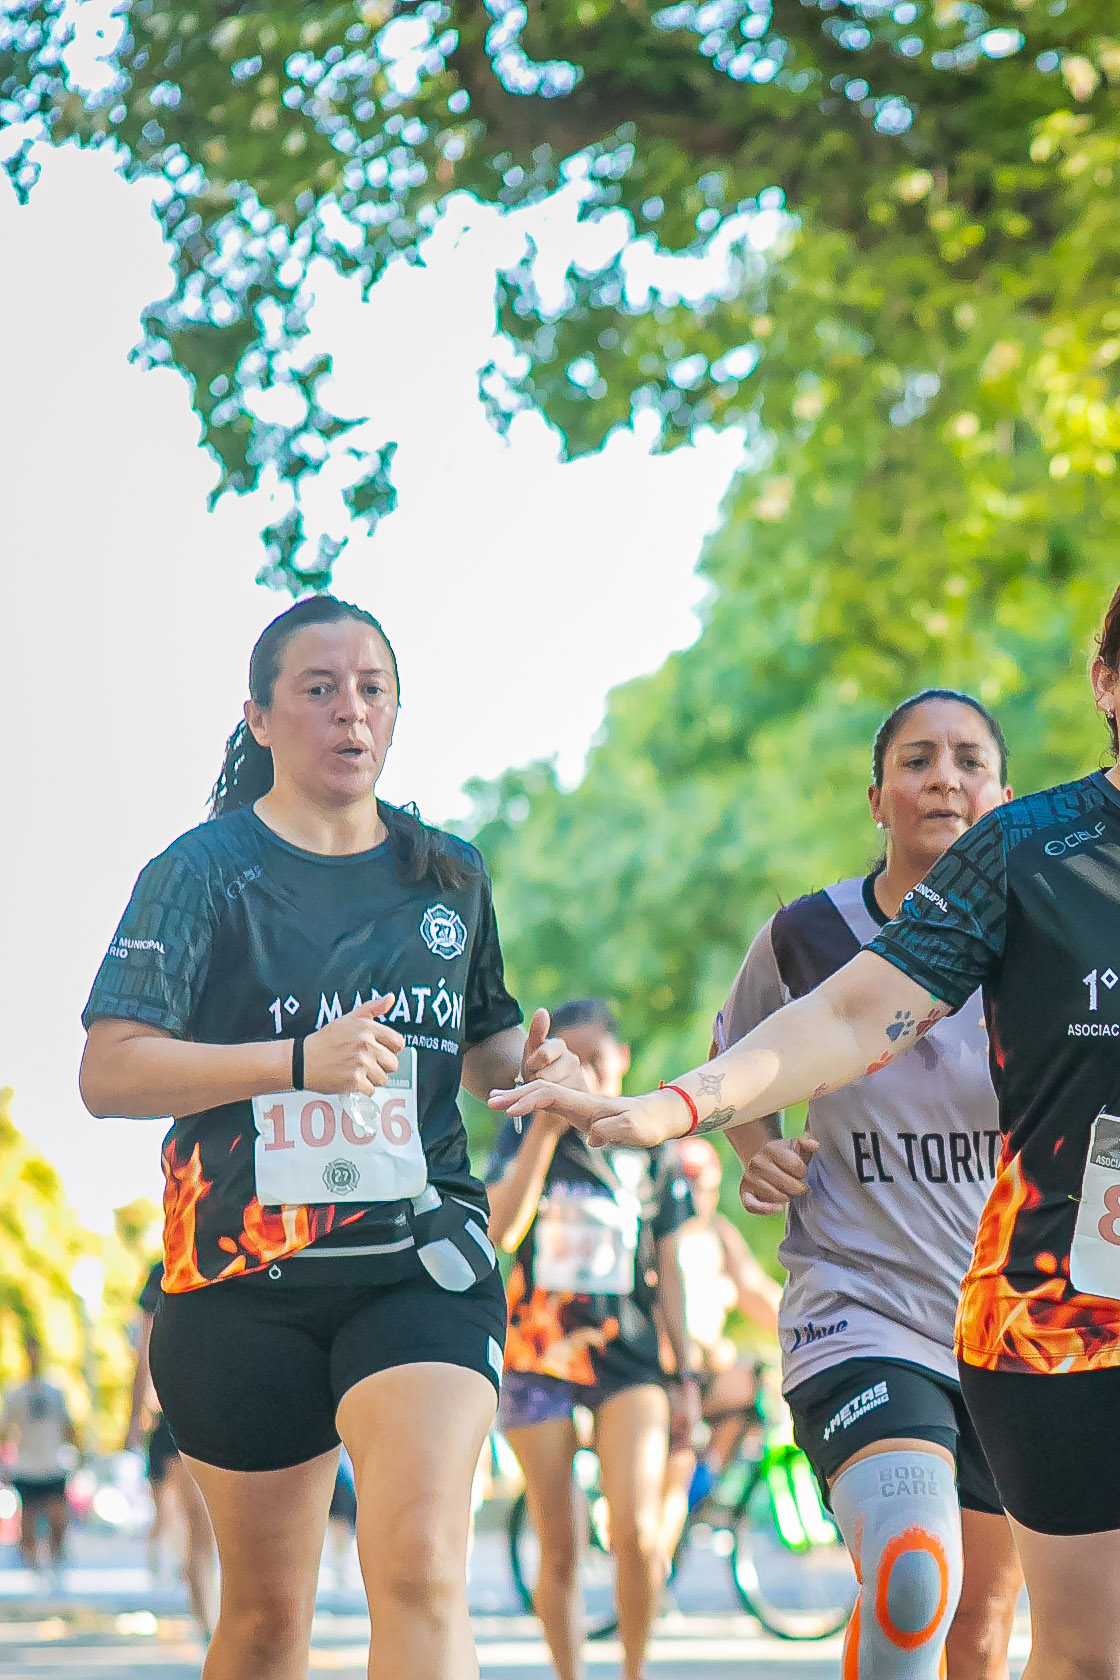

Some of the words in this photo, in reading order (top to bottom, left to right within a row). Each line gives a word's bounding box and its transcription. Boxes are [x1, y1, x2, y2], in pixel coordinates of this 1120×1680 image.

[912, 882, 948, 913] UNICIPAL
[119, 937, 166, 954] MUNICIPAL
[404, 1034, 439, 1050] TARIOS
[851, 1131, 894, 1184] EL
[896, 1130, 1001, 1184] TORIT
[843, 1393, 890, 1430] RUNNING
[879, 1466, 936, 1482] BODY
[880, 1479, 939, 1498] CARE
